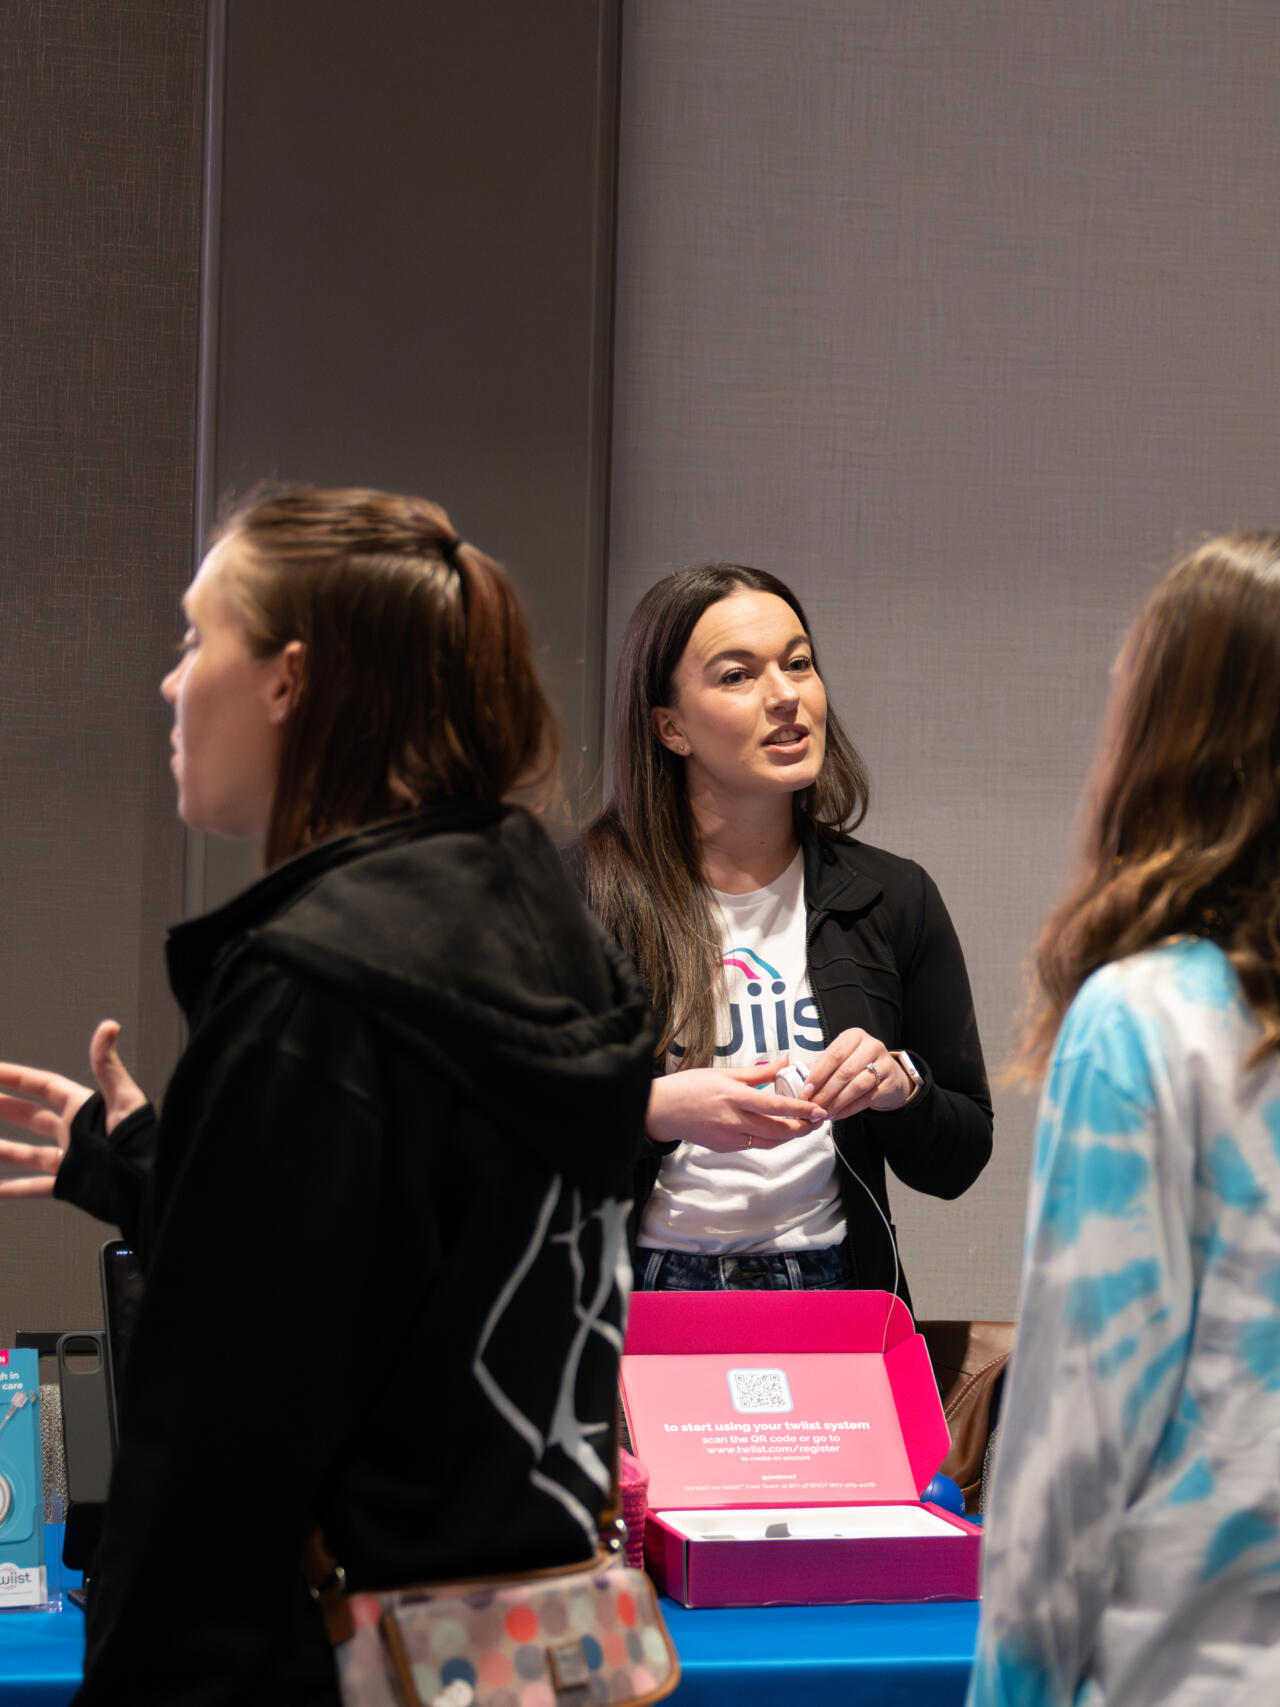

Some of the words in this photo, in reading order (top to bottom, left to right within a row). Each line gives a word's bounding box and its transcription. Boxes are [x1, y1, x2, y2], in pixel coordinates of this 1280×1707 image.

[663, 1423, 679, 1432] to
[680, 1422, 713, 1432] start
[714, 1421, 752, 1433] using
[752, 1423, 783, 1433] your
[823, 1421, 870, 1432] system
[701, 1436, 729, 1444] scan
[729, 1435, 749, 1443] the
[750, 1434, 767, 1443] QR
[769, 1434, 797, 1442] code
[812, 1435, 828, 1444] go
[829, 1434, 841, 1442] to
